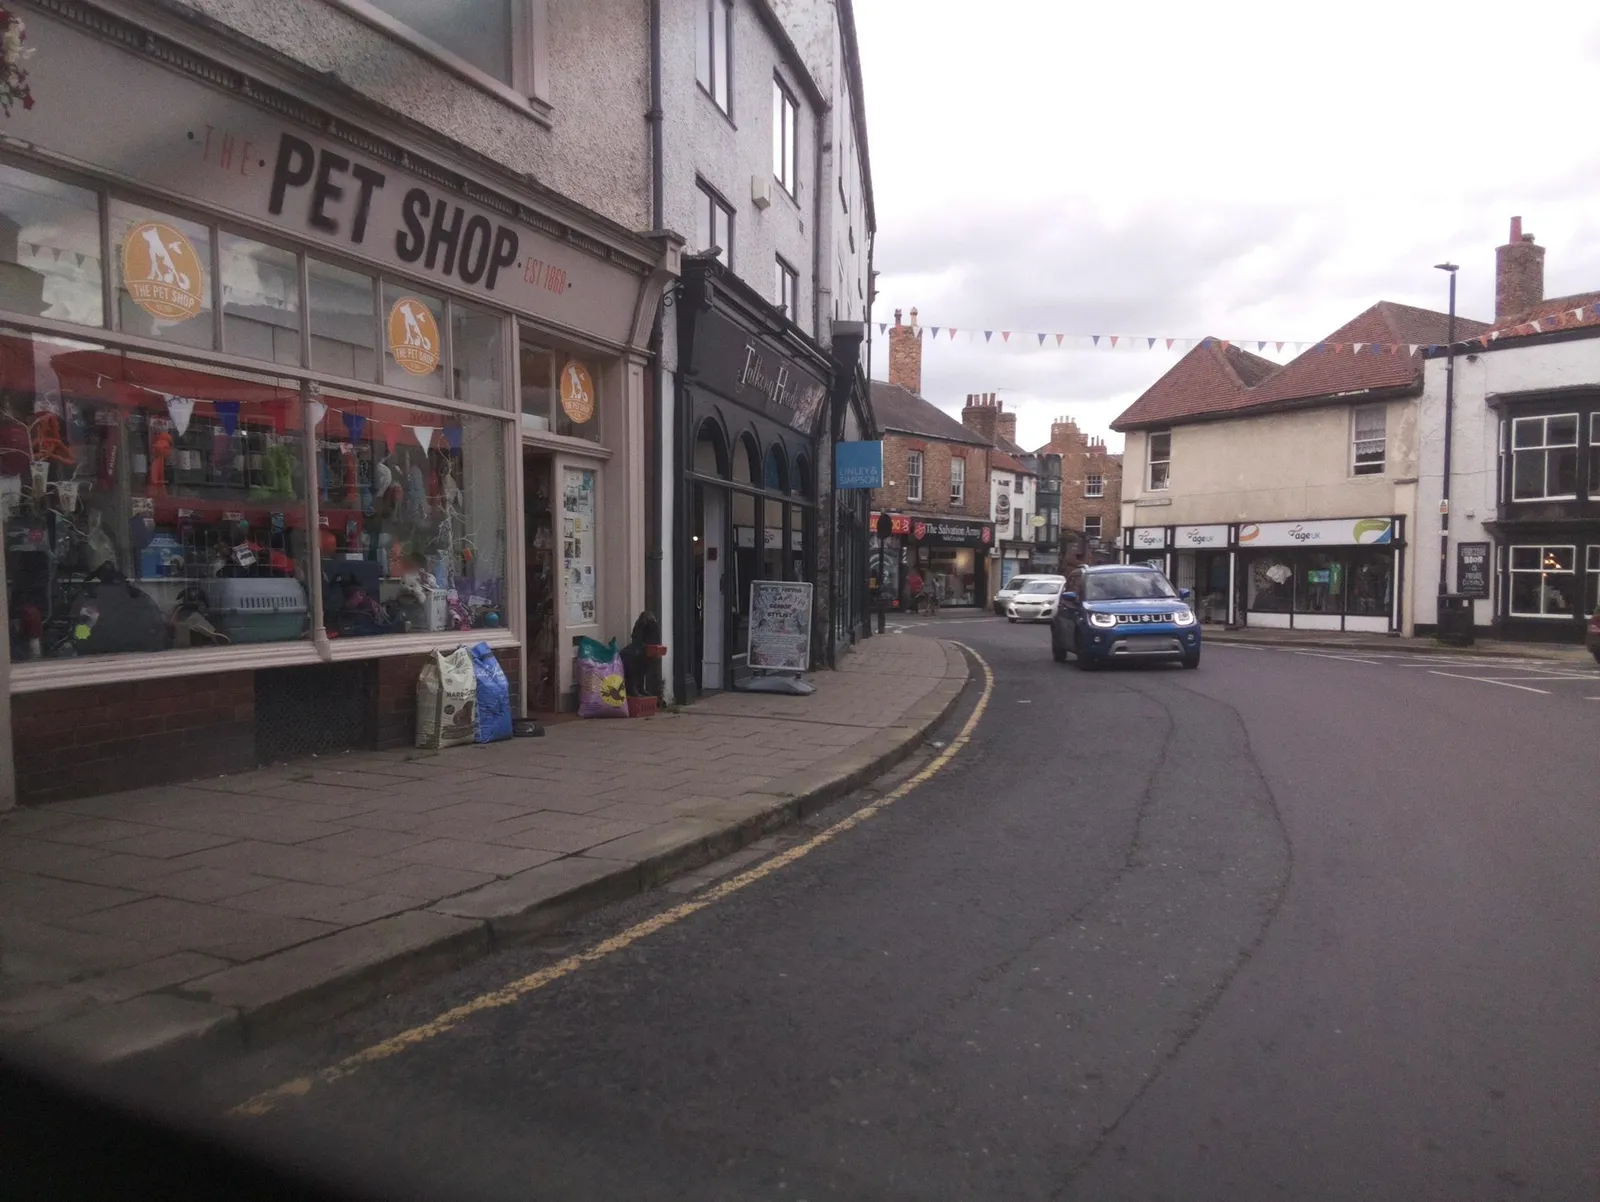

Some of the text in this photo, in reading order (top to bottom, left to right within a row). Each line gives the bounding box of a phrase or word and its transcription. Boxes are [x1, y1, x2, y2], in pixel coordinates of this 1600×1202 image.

[203, 123, 567, 295] THE PET SHOP EST 1868
[133, 284, 151, 298] THE
[152, 285, 169, 300] PET
[171, 290, 195, 308] SHOP
[407, 348, 418, 360] PET
[840, 467, 869, 476] LINLEY
[840, 477, 878, 485] SIMPSON
[926, 524, 938, 534] The
[938, 524, 964, 535] Salvation
[965, 525, 980, 539] Army
